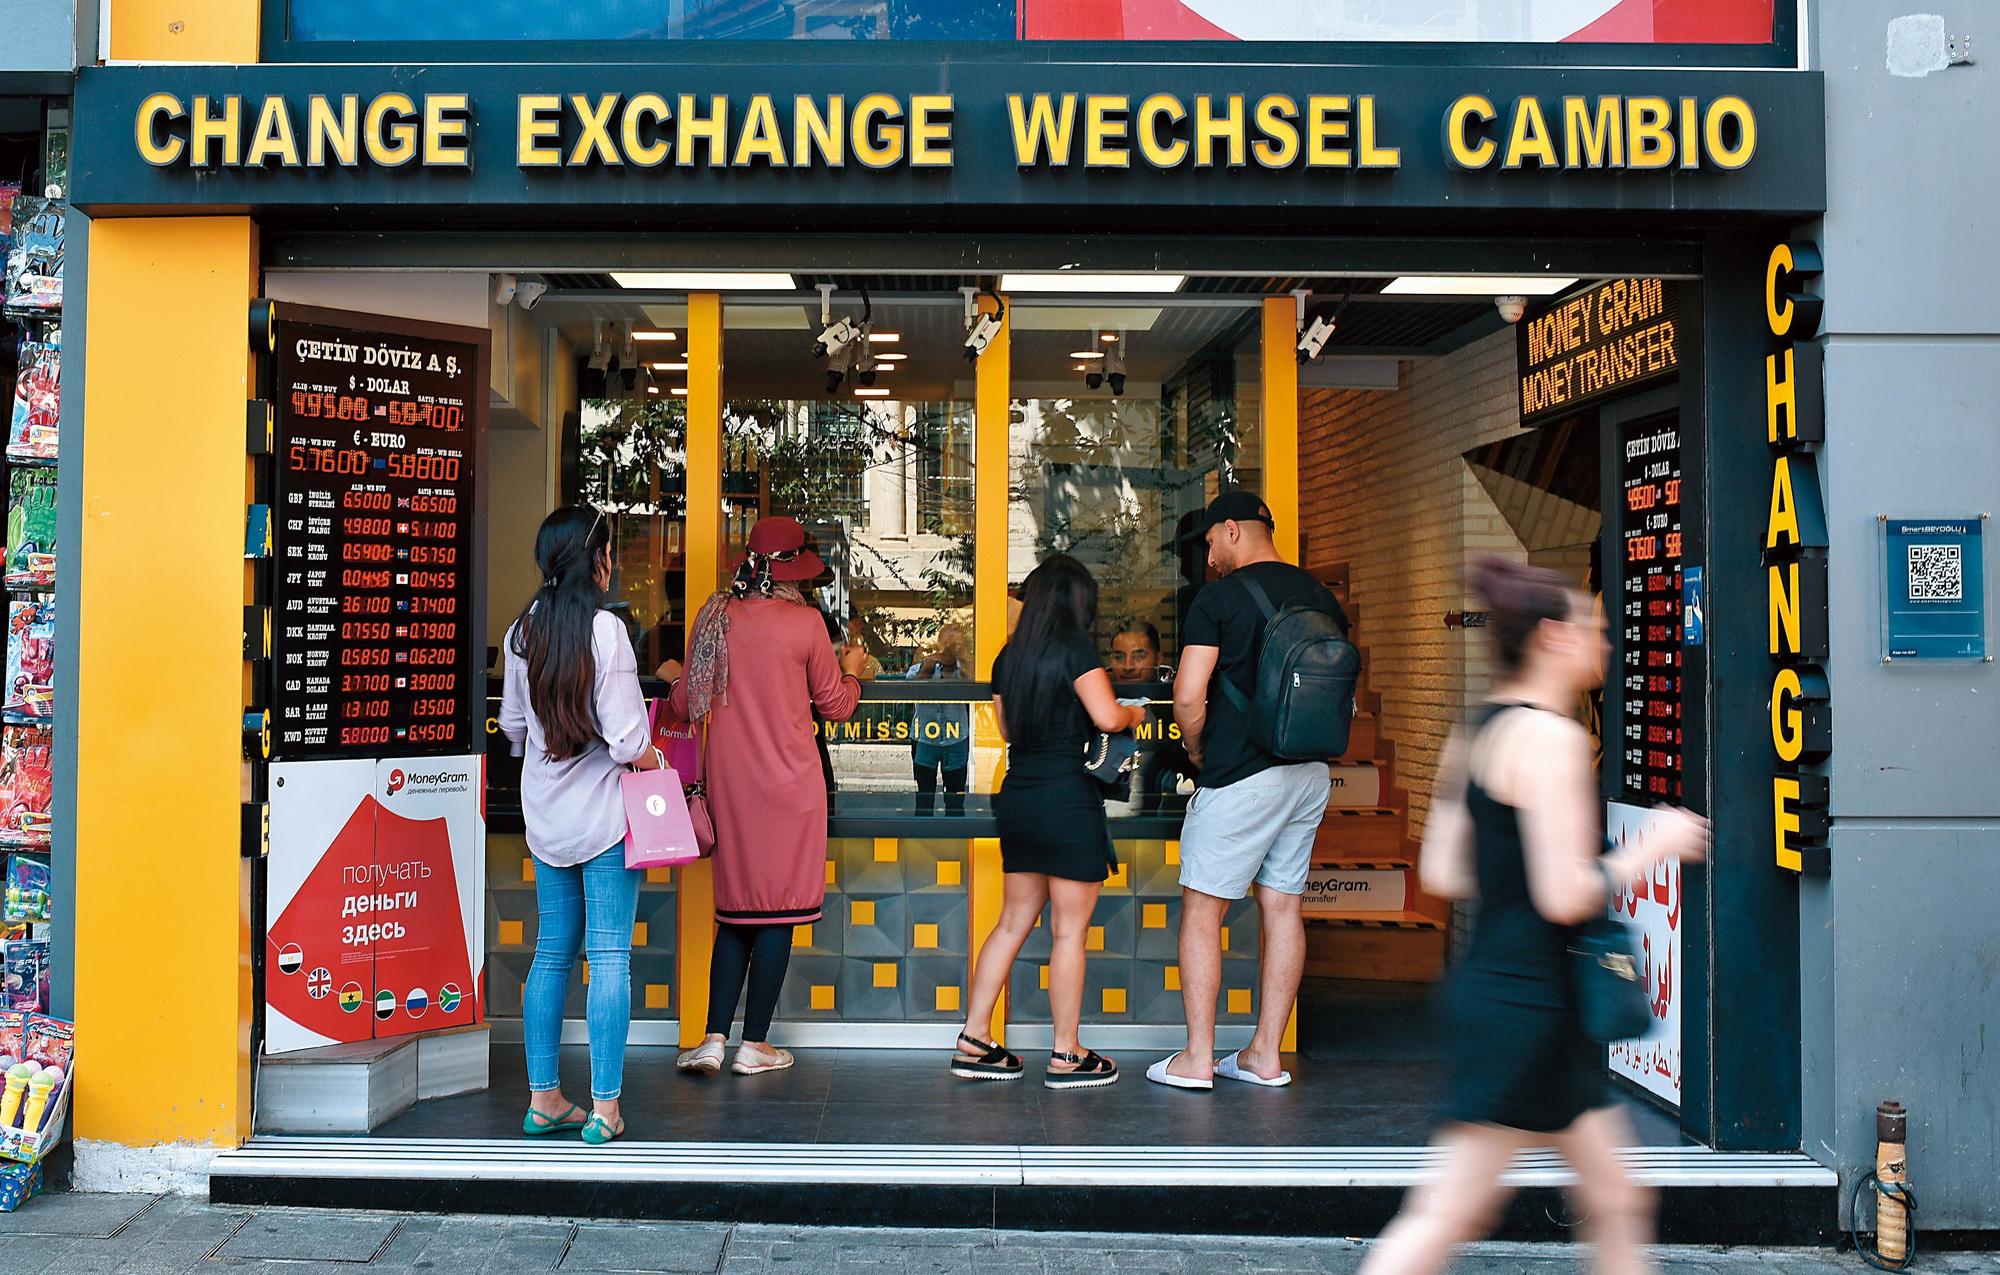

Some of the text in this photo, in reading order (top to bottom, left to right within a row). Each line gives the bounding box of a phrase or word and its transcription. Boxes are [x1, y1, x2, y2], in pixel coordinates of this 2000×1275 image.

[134, 92, 1757, 169] CHANGE EXCHANGE WECHSEL CAMBIO
[1528, 278, 1663, 366] MONEY GRAM
[296, 338, 358, 363] ÇETİN
[364, 343, 421, 370] DÖVİZ
[1522, 321, 1676, 414] MONEY TRANSFER
[293, 383, 307, 392] ALIŞ
[312, 384, 322, 392] WE
[324, 385, 337, 393] BUY
[350, 375, 355, 390] $
[367, 378, 410, 394] DOLAR
[418, 396, 434, 405] SATIŞ
[291, 437, 306, 447] ALIŞ
[323, 439, 336, 447] BUY
[354, 430, 360, 445] €
[371, 432, 405, 449] EURO
[1626, 428, 1676, 462] ÇETİN DÖVİZ
[1652, 461, 1669, 478] DOLAR
[289, 493, 303, 503] GBP
[288, 520, 303, 530] CHF
[1653, 513, 1668, 529] EURO
[288, 547, 302, 556] SEK
[1766, 243, 1803, 873] CHANGE
[287, 573, 301, 584] JPY
[287, 600, 302, 610] AUD
[287, 627, 303, 637] DKK
[286, 654, 302, 664] NOK
[286, 681, 300, 690] CAD
[286, 707, 300, 718] SAR
[660, 726, 688, 740] florma
[812, 718, 960, 740] MMİSSİON
[284, 732, 301, 742] KWD
[343, 861, 431, 887] получать
[341, 891, 417, 918] деньги
[342, 921, 405, 946] здесь
